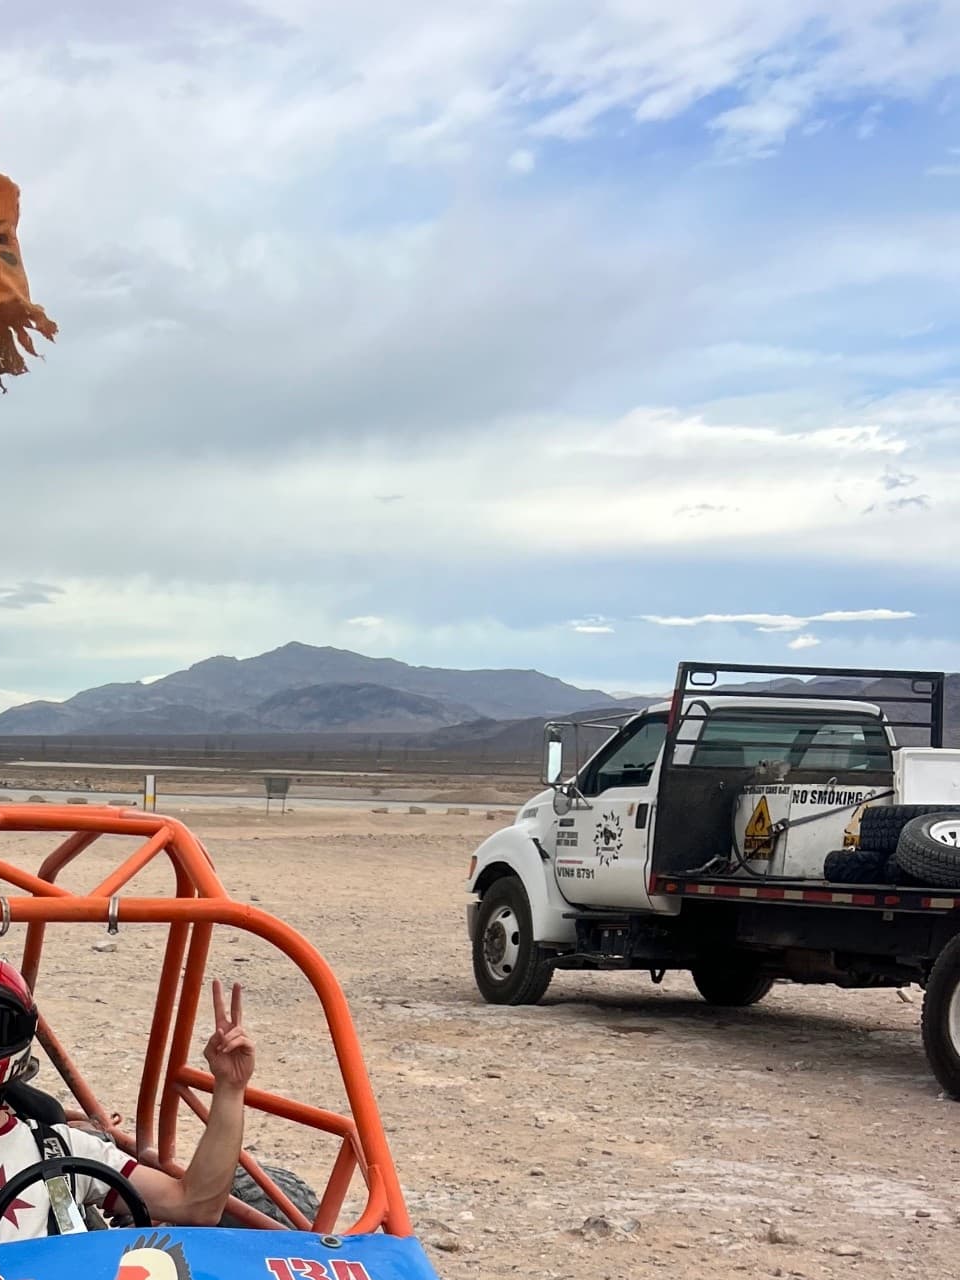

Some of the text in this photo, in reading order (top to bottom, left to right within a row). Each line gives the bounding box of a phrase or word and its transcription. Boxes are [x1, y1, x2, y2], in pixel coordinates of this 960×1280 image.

[792, 789, 808, 804] NO
[809, 790, 864, 806] SMOKING
[556, 866, 575, 878] VIN#
